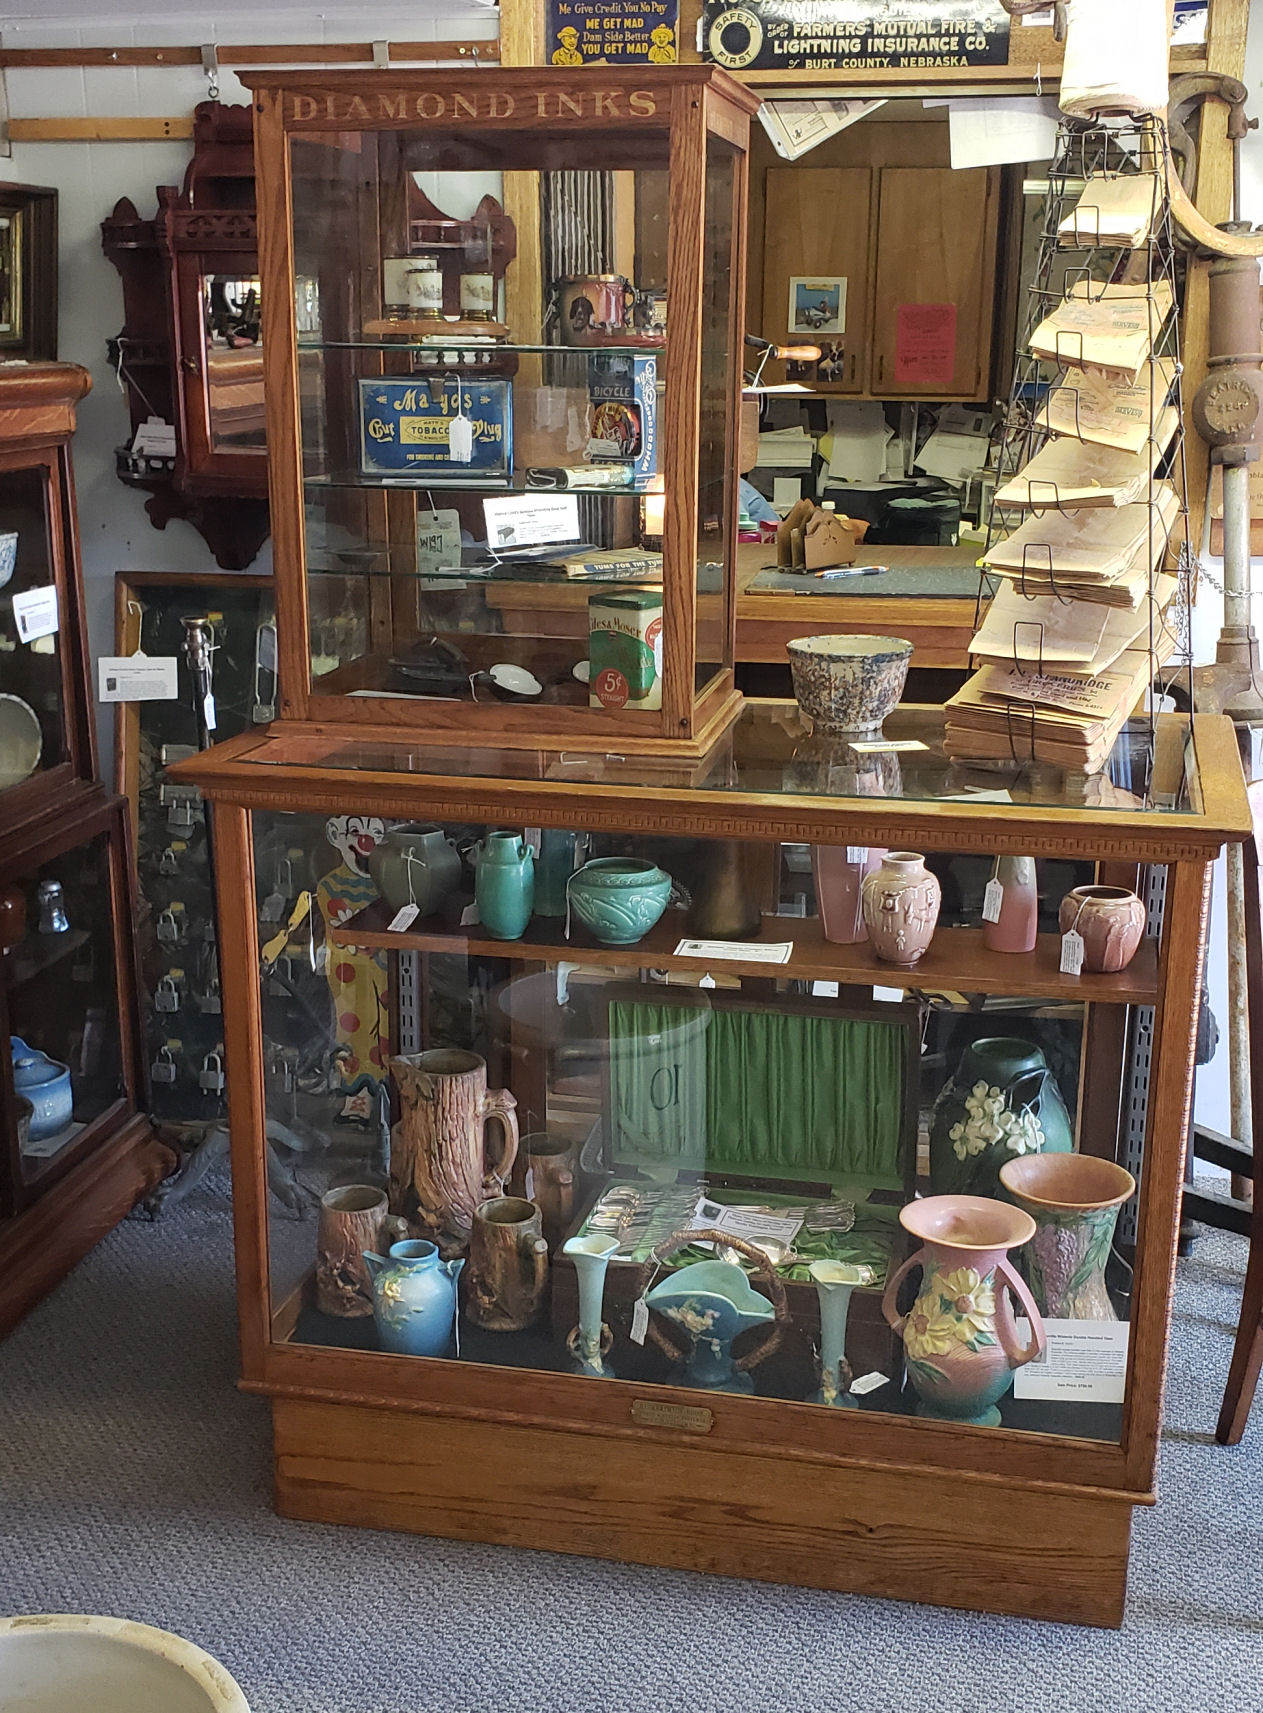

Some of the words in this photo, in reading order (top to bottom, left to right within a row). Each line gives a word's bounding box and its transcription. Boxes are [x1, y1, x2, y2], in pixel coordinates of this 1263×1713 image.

[559, 3, 571, 14] Me
[574, 3, 593, 14] Give
[595, 3, 622, 13] Credit
[624, 2, 639, 13] You
[640, 2, 651, 13] No
[651, 1, 668, 15] Pay
[585, 18, 600, 29] ME
[603, 18, 622, 29] GET
[624, 18, 644, 28] MAD
[714, 12, 757, 31] SAFETY
[873, 19, 937, 36] MUTUAL
[941, 18, 976, 34] FIRE
[983, 17, 997, 33] &
[583, 32, 602, 42] Dam
[604, 31, 624, 41] Side
[624, 32, 649, 42] Better
[582, 43, 600, 55] YOU
[604, 43, 624, 54] GET
[627, 42, 648, 54] MAD
[774, 38, 861, 54] LIGHTNING
[867, 36, 959, 52] INSURANCE
[965, 36, 990, 50] CO.
[717, 50, 752, 65] FIRST
[805, 59, 836, 69] BURT
[900, 56, 968, 67] NEBRASKA
[292, 92, 514, 121] DIAMOND
[536, 91, 657, 118] INKS
[593, 386, 631, 397] BICYCLE
[368, 418, 395, 442] Cut
[411, 426, 450, 435] TOBACC
[593, 563, 614, 571] TUMS
[604, 672, 622, 692] 5¢
